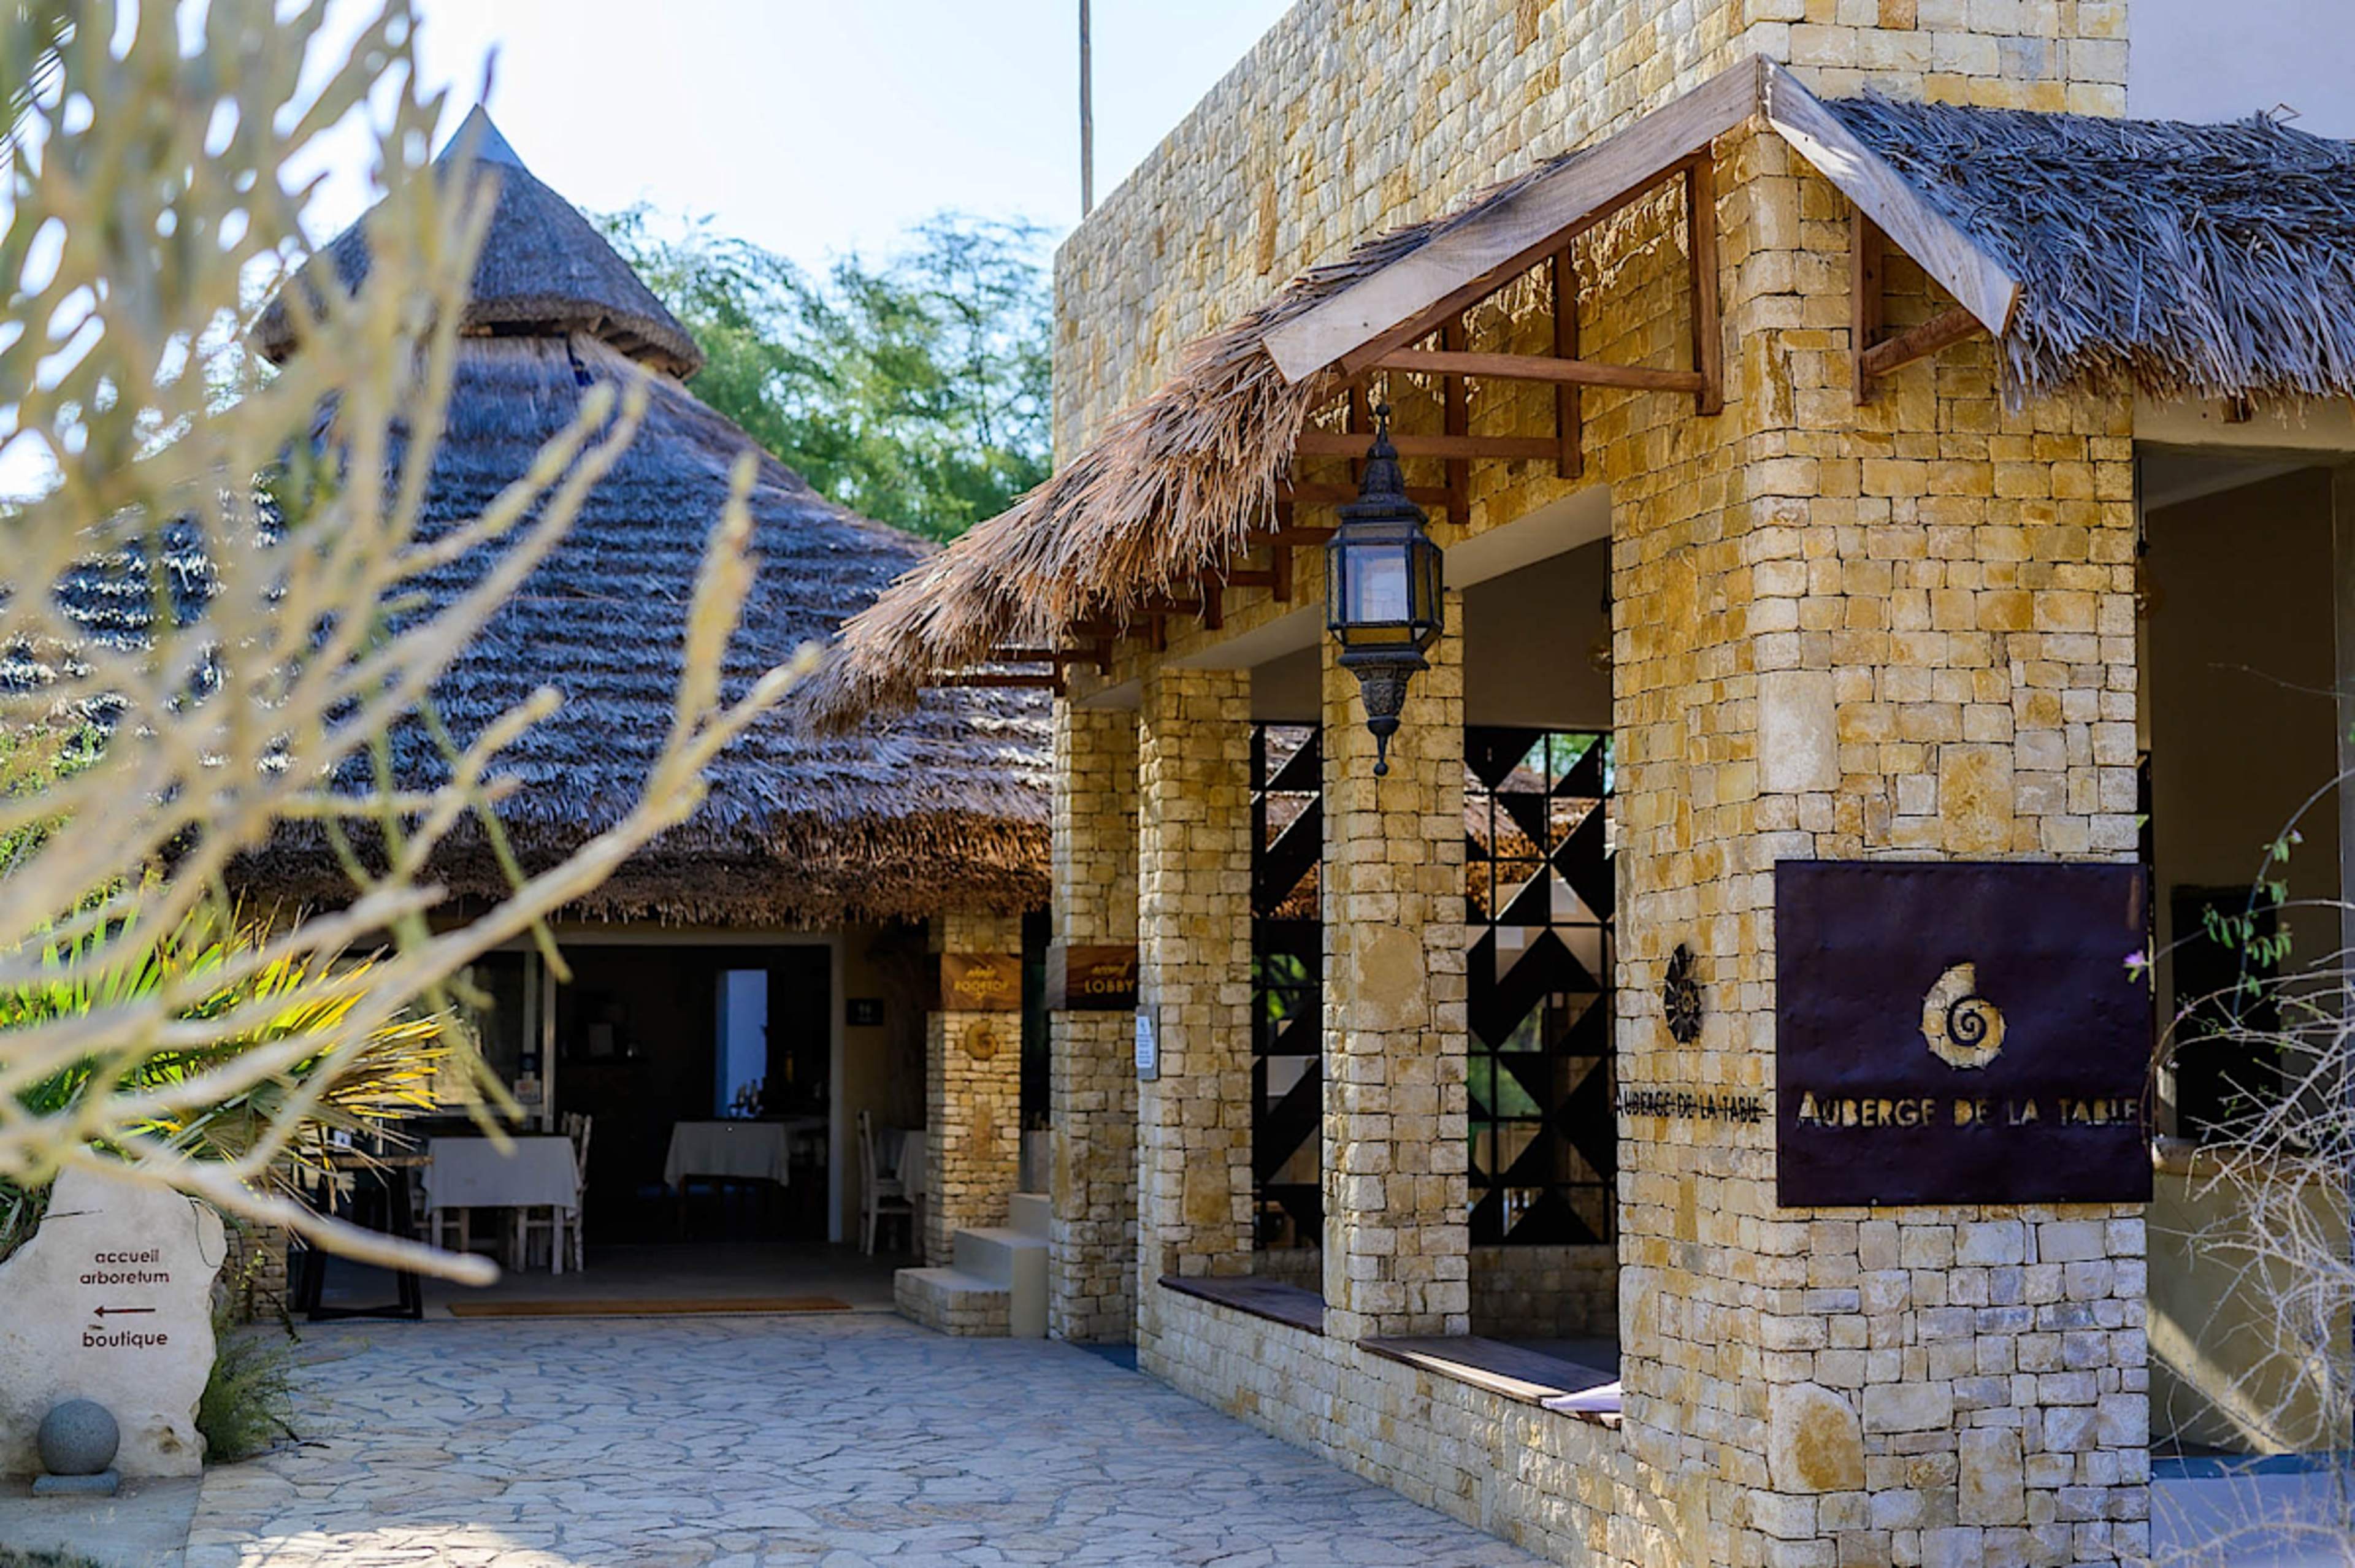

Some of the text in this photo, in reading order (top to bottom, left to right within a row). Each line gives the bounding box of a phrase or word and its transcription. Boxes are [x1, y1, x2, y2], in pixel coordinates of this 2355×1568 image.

[1084, 979, 1135, 993] LOBBY
[1615, 1090, 1761, 1123] AUBERGE DE LA TABLE
[1796, 1090, 2138, 1128] AUBERGE DE LA TABLE
[95, 1249, 159, 1263] accueil
[80, 1270, 170, 1285] arboretum
[82, 1330, 167, 1348] boutique
